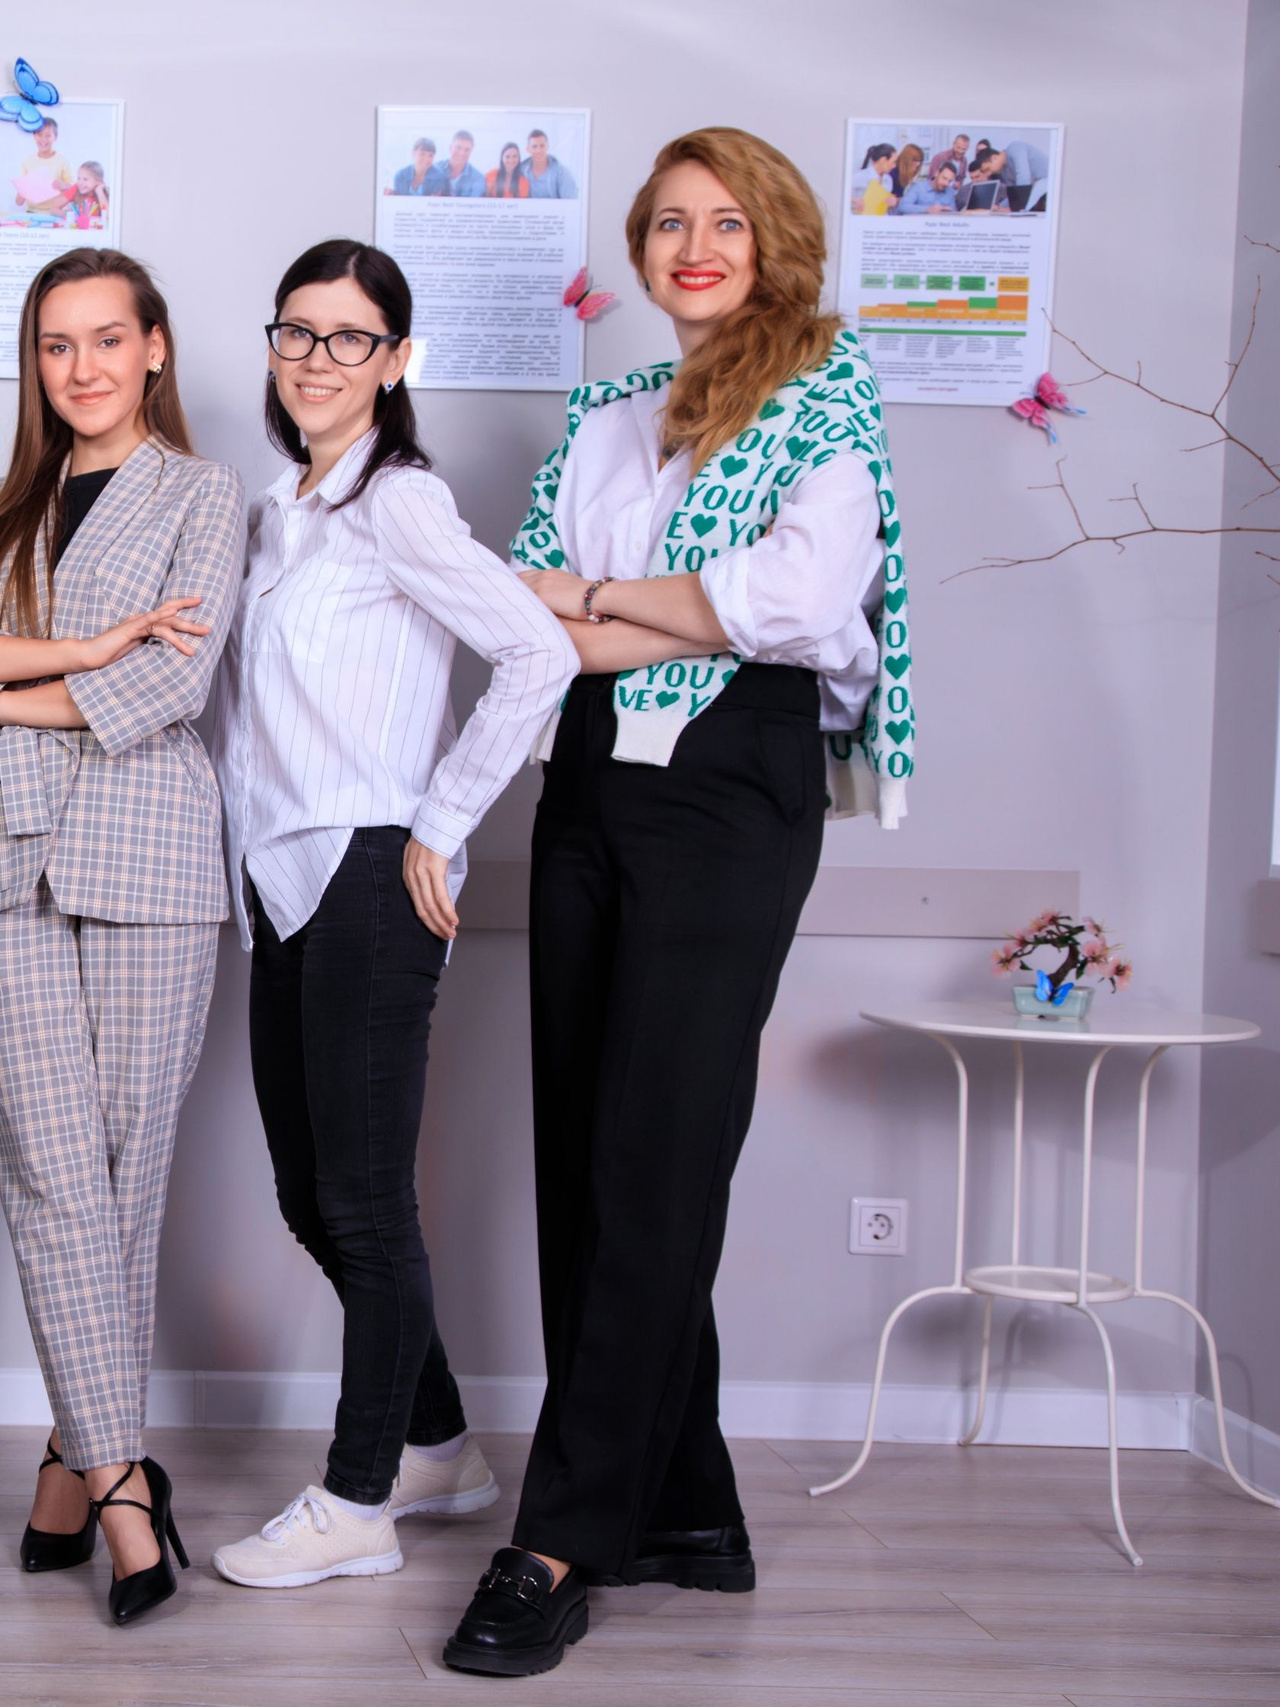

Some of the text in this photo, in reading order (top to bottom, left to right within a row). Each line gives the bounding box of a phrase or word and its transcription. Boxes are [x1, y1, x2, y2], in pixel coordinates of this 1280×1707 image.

[684, 482, 755, 515] YOU
[666, 511, 689, 539] E
[646, 661, 715, 690] YOU
